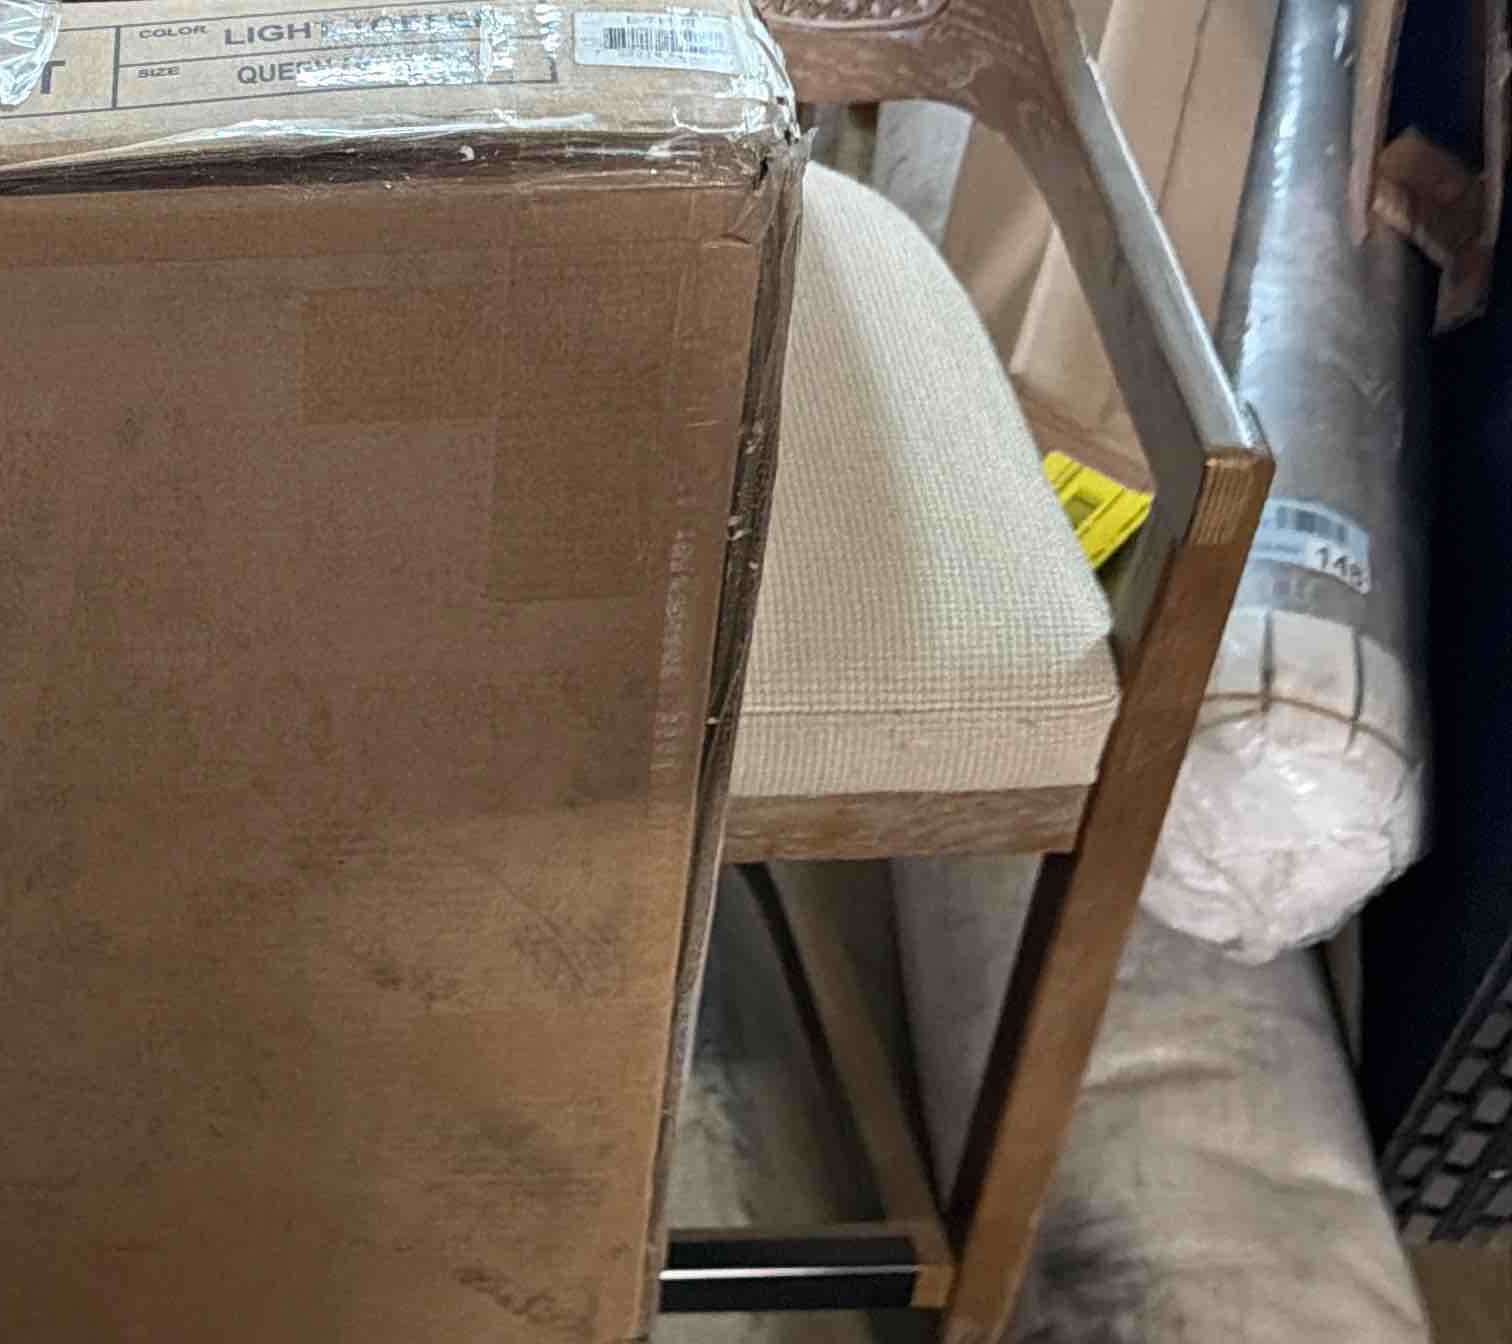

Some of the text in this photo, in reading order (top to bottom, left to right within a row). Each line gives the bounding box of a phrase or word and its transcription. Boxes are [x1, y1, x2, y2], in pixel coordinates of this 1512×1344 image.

[139, 24, 207, 39] COLOR
[224, 21, 336, 46] LIGH
[138, 66, 180, 79] SIZE
